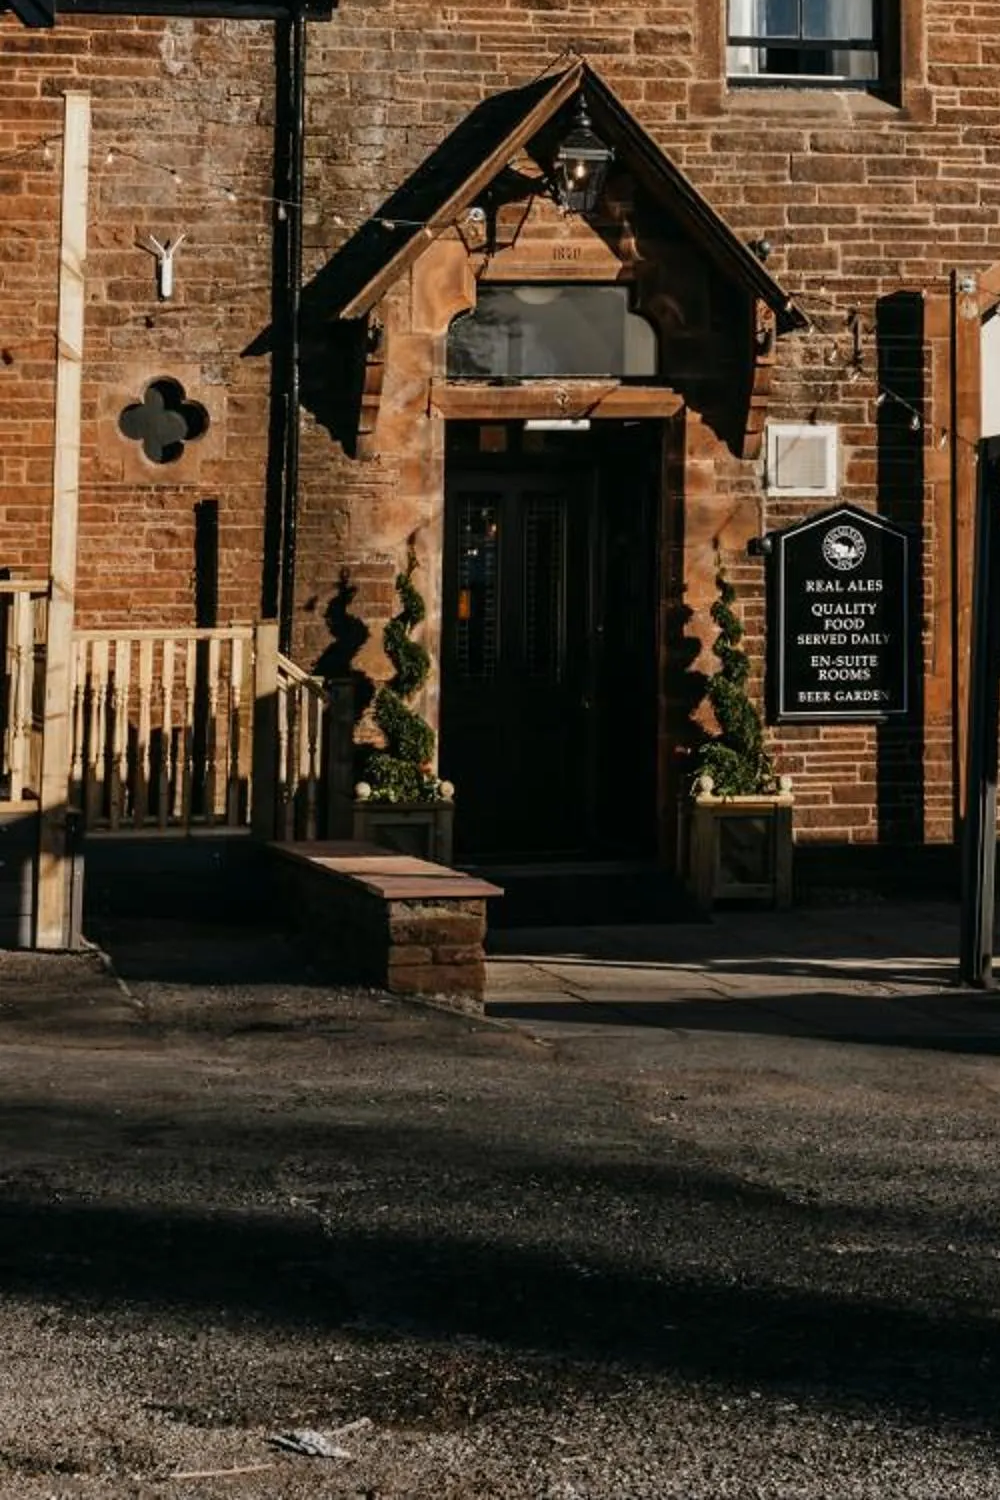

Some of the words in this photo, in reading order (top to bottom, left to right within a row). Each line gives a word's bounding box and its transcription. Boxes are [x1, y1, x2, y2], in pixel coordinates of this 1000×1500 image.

[805, 579, 843, 592] REAL
[848, 579, 883, 592] ALES
[811, 603, 877, 616] QUALITY
[824, 617, 865, 631] FOOD
[797, 633, 847, 645] SERVED
[851, 633, 890, 645] DAILY
[811, 655, 878, 667] EN-SUITE
[818, 668, 871, 681] ROOMS
[798, 691, 831, 703] BEER
